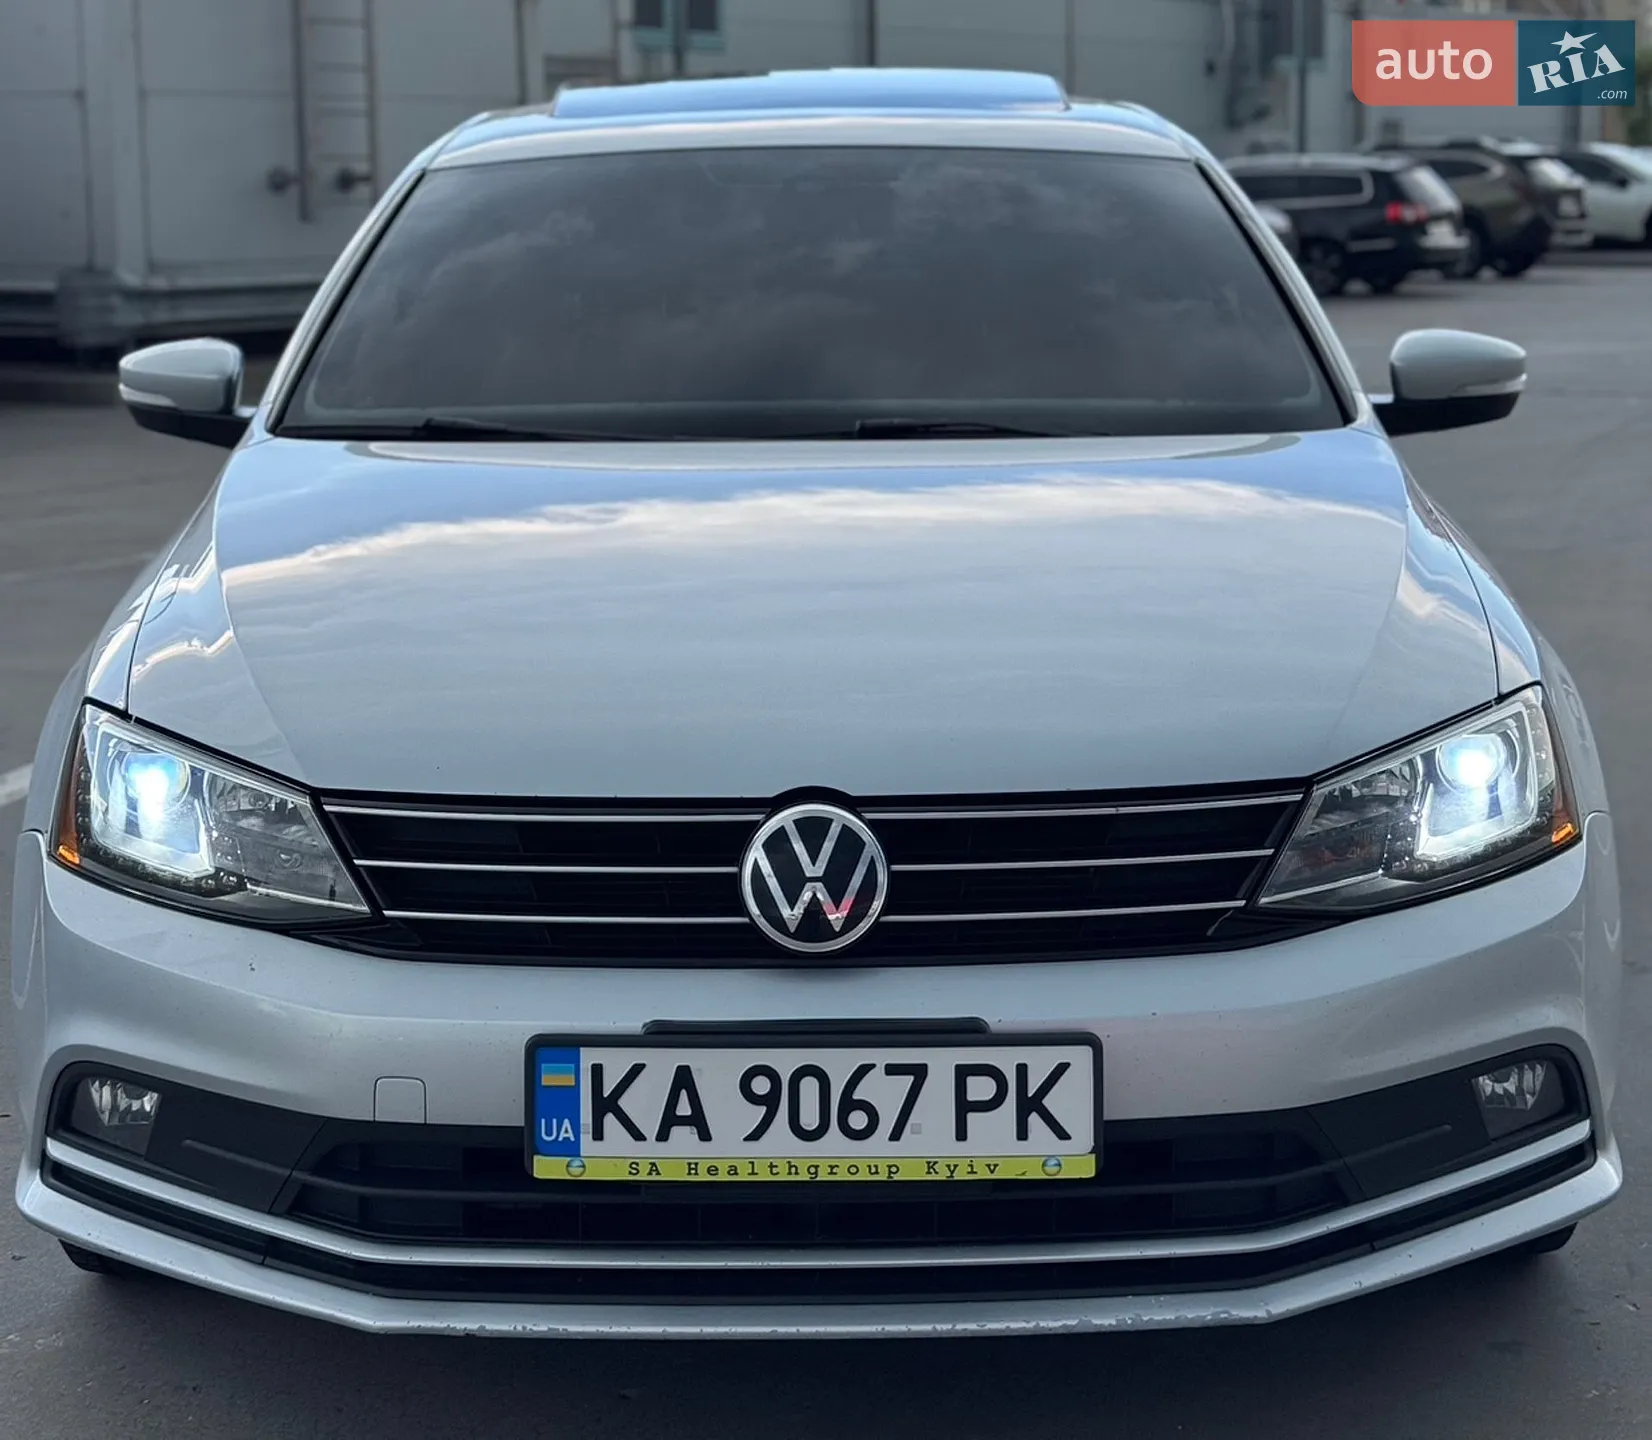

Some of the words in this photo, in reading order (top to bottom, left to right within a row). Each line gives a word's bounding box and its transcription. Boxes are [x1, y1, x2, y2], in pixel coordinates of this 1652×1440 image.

[590, 1062, 712, 1142] KA
[738, 1063, 928, 1142] 9067
[954, 1062, 1072, 1142] PK
[541, 1118, 575, 1142] UA
[628, 1161, 662, 1176] SA
[687, 1160, 900, 1180] Healthgroup
[925, 1160, 1000, 1179] Kyiv
